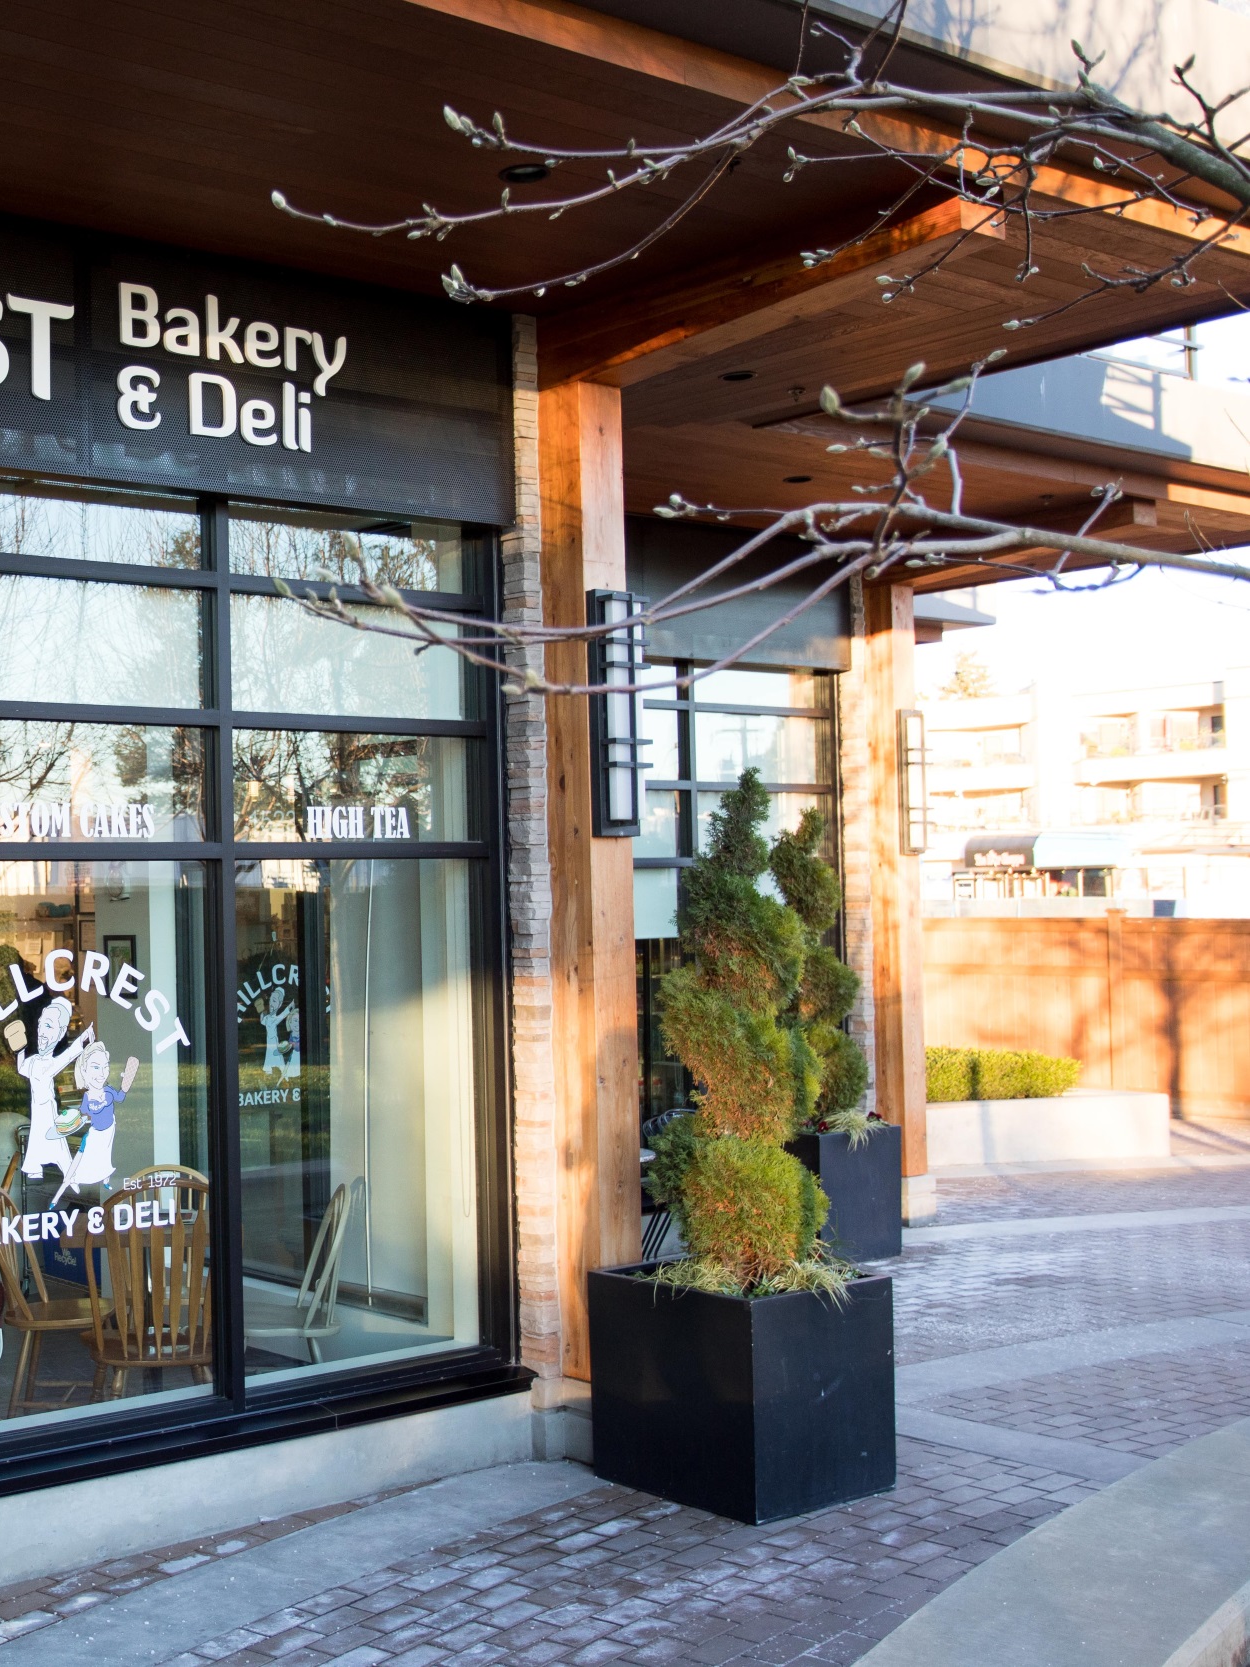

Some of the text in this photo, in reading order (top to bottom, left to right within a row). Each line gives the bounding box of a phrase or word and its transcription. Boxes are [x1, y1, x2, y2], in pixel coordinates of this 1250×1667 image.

[119, 282, 346, 397] Bakery
[117, 366, 311, 453] & Deli
[80, 803, 155, 838] CAKES
[307, 806, 411, 839] HIGH TEA
[123, 1173, 177, 1191] Est 1972
[87, 1206, 105, 1234] &
[113, 1199, 176, 1231] DELI
